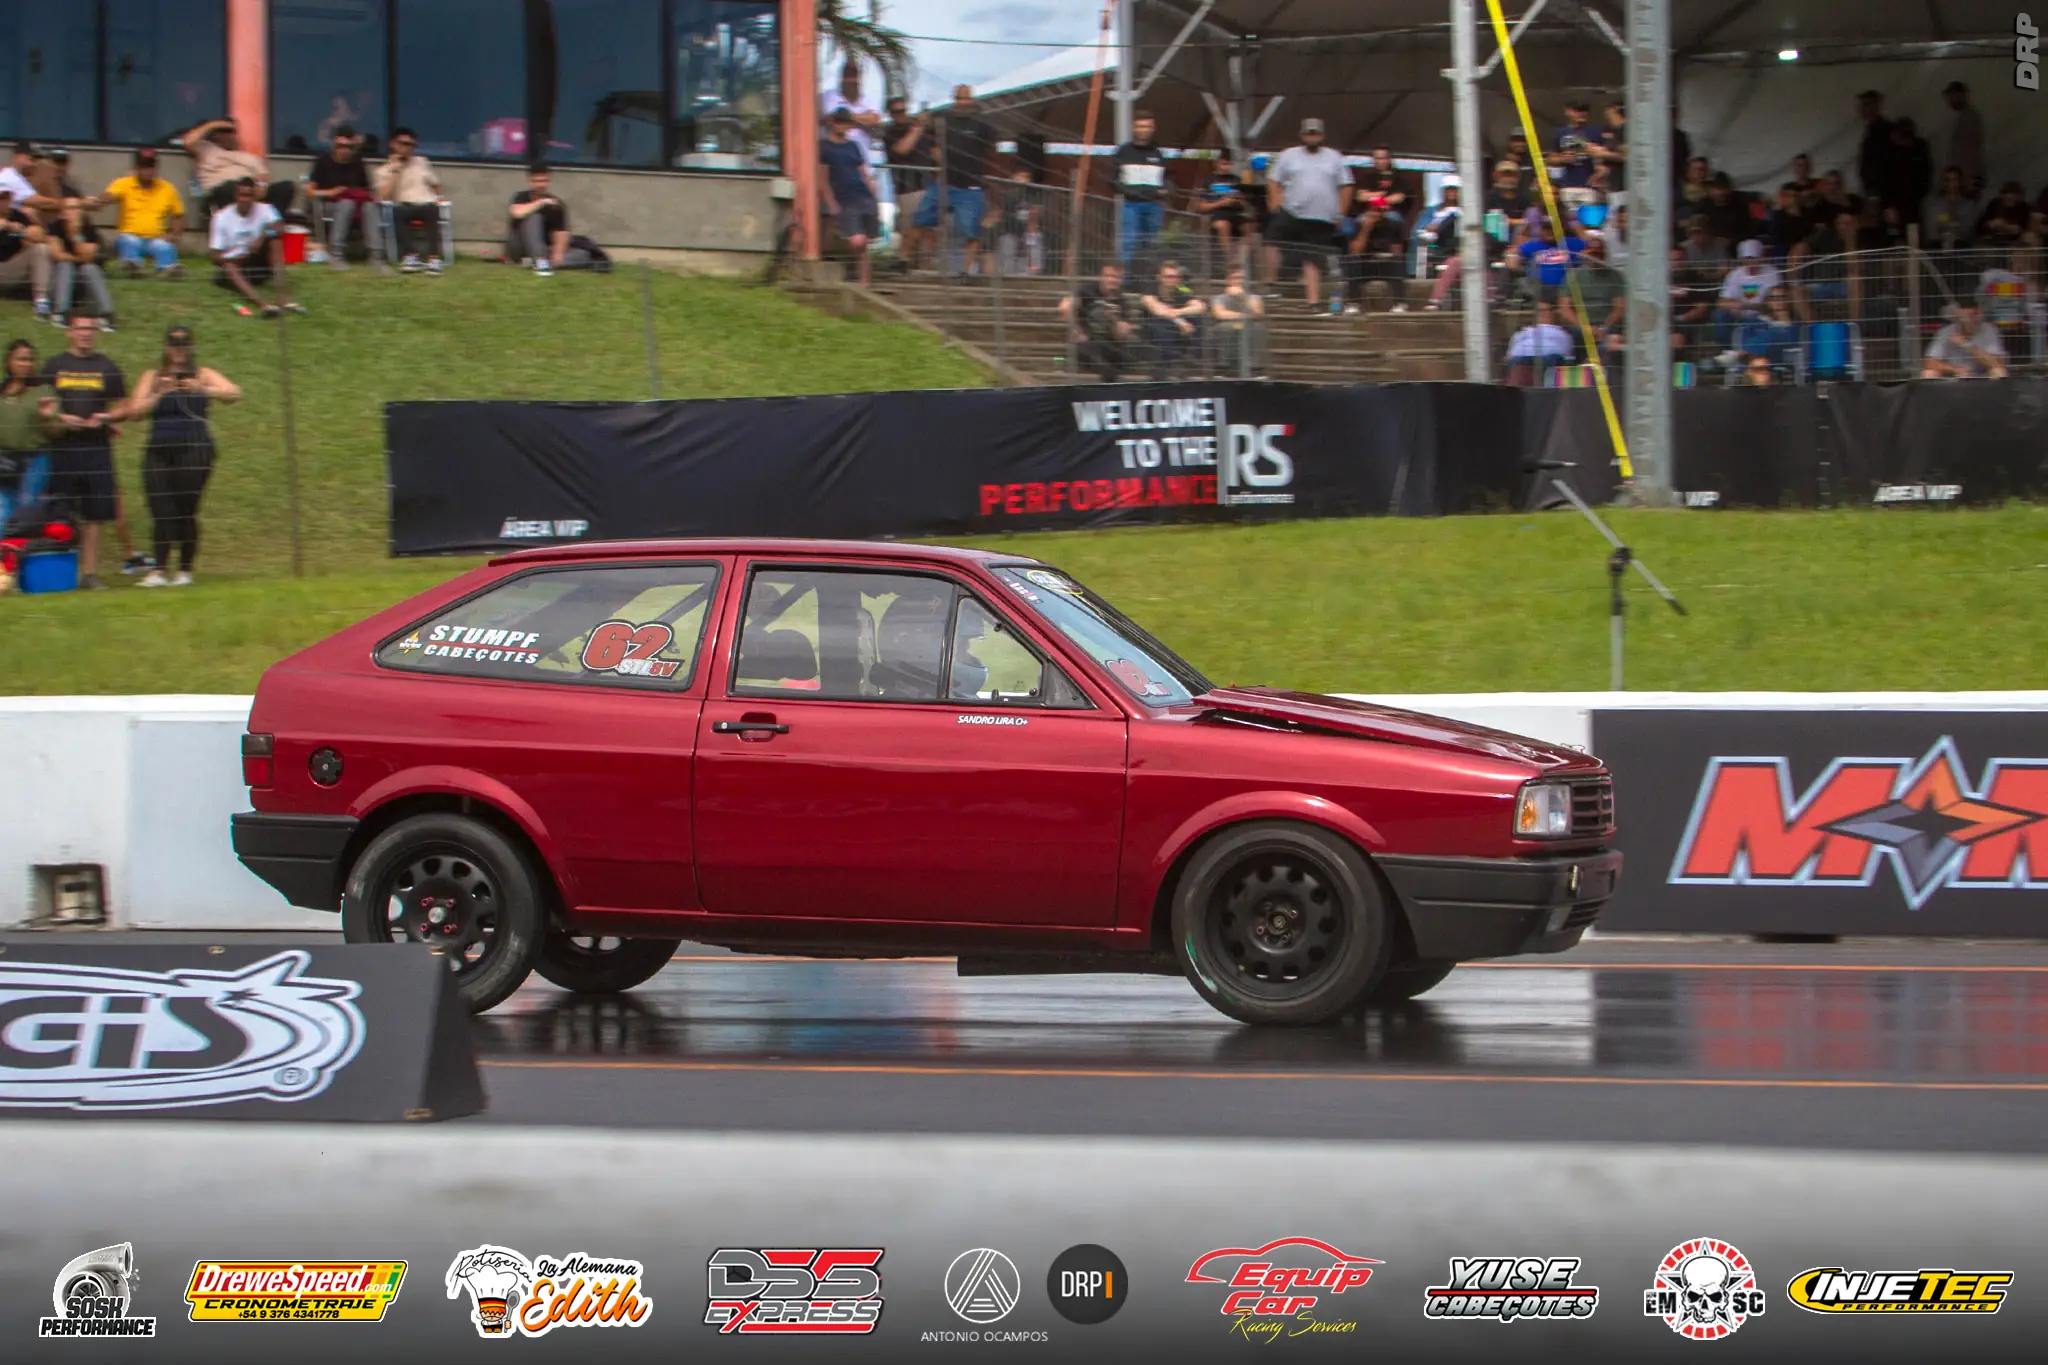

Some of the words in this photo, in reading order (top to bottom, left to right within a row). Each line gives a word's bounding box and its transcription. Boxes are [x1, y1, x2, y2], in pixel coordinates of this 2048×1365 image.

[1072, 398, 1216, 431] WELCOME
[1115, 439, 1162, 468] TO
[1161, 436, 1217, 466] THE
[1226, 424, 1294, 487] RS
[979, 475, 1218, 514] PERFORMANCE
[1926, 484, 1962, 500] VIP
[554, 520, 590, 536] VIP
[429, 625, 540, 648] STUMPF
[582, 622, 673, 671] 62
[423, 644, 540, 664] CABEÇOTES
[957, 715, 995, 725] SANDRO
[995, 716, 1015, 725] LIRA
